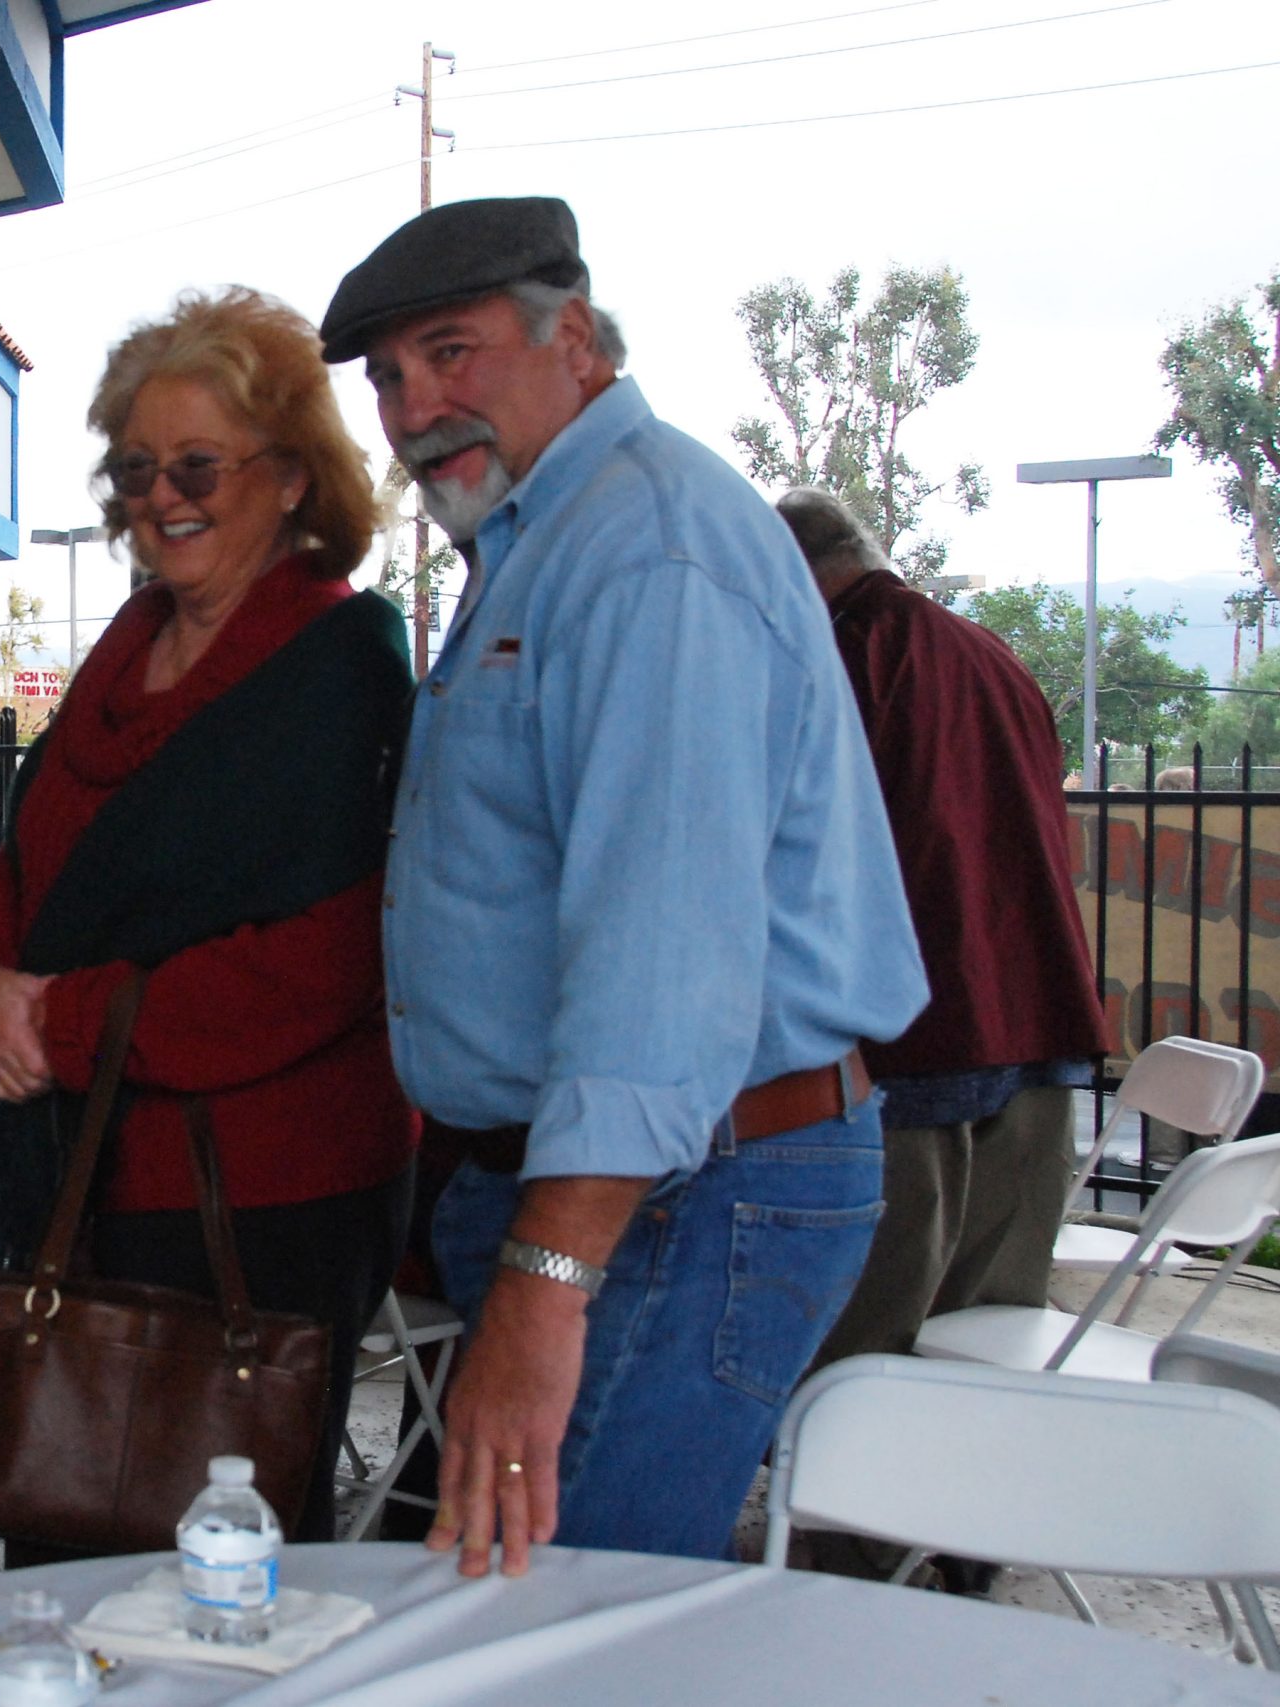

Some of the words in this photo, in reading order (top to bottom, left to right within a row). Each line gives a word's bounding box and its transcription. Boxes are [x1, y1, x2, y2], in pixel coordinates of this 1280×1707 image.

[14, 671, 38, 683] DCH
[42, 672, 63, 684] TO
[14, 685, 40, 696] SIMI
[43, 686, 62, 696] VA
